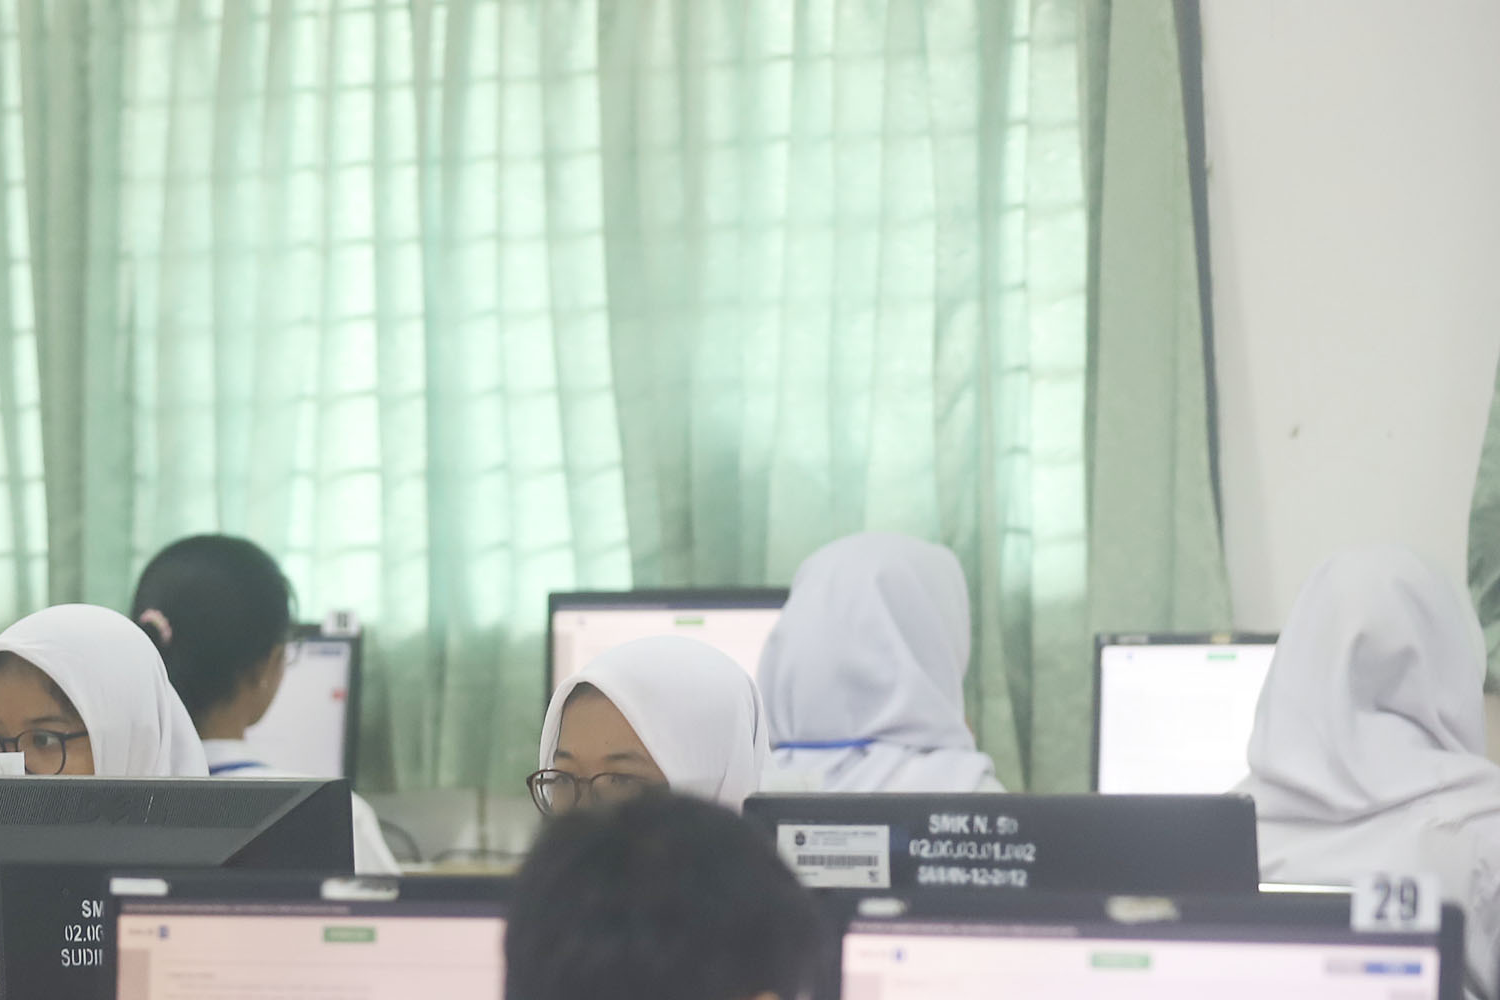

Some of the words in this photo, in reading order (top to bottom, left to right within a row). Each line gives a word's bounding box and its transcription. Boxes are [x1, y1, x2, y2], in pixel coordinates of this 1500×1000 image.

[929, 814, 971, 834] SMK
[974, 815, 992, 834] N.
[1374, 872, 1418, 920] 29
[81, 900, 104, 918] SM
